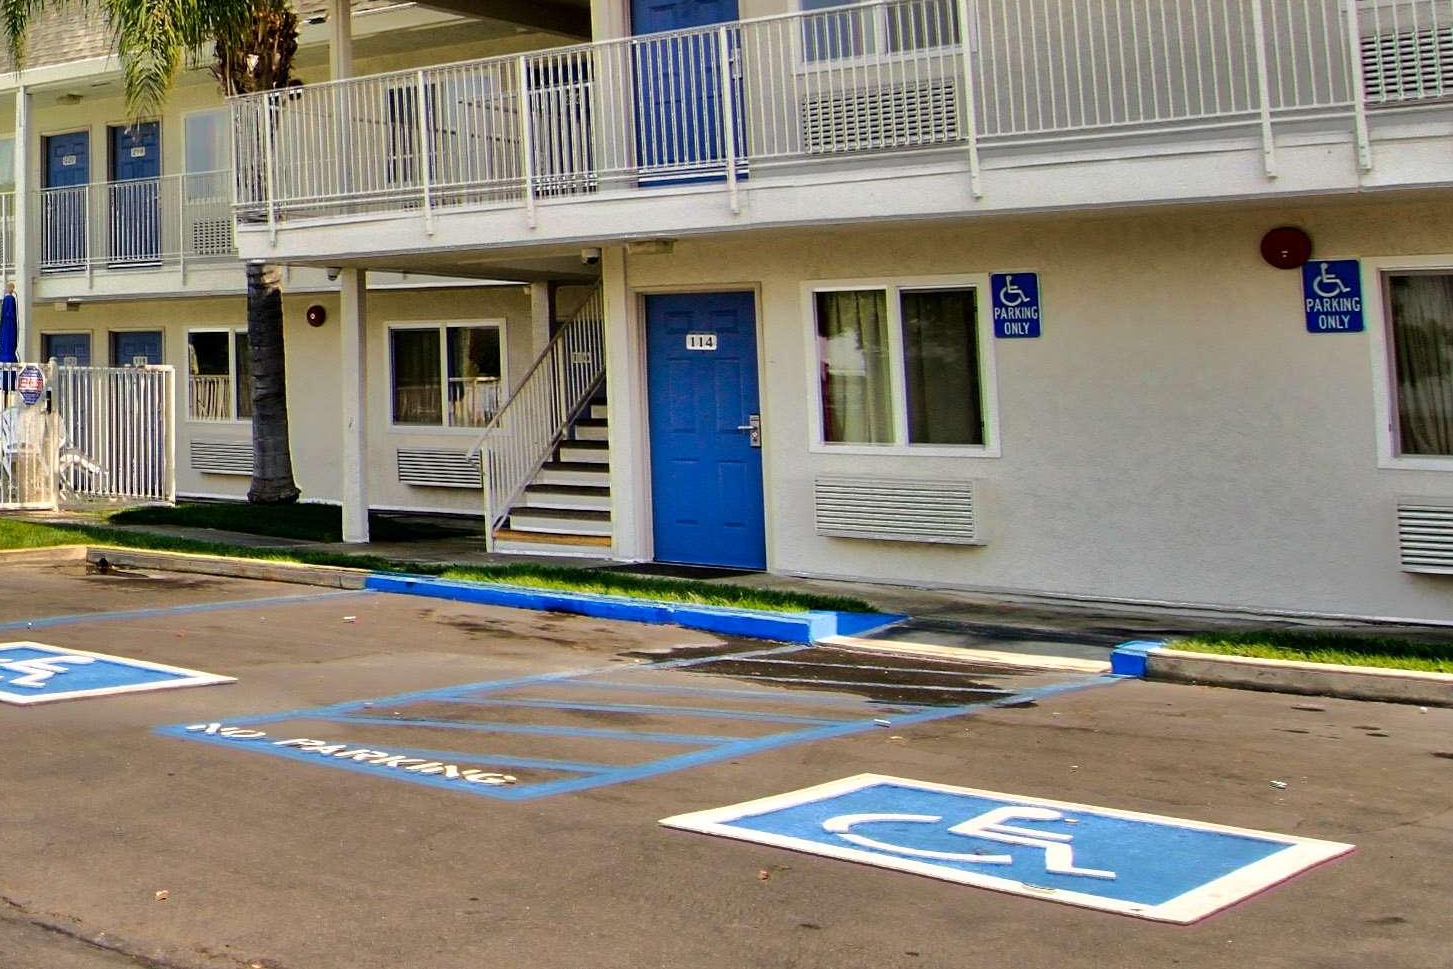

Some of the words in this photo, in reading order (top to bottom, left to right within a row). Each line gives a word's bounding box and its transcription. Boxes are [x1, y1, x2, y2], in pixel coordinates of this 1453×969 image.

[1305, 297, 1360, 313] PARKING
[994, 306, 1038, 320] PARKING
[1004, 321, 1030, 335] ONLY
[1318, 314, 1350, 329] ONLY
[691, 336, 713, 348] 114
[185, 722, 267, 739] NO
[272, 738, 517, 785] PARKING
